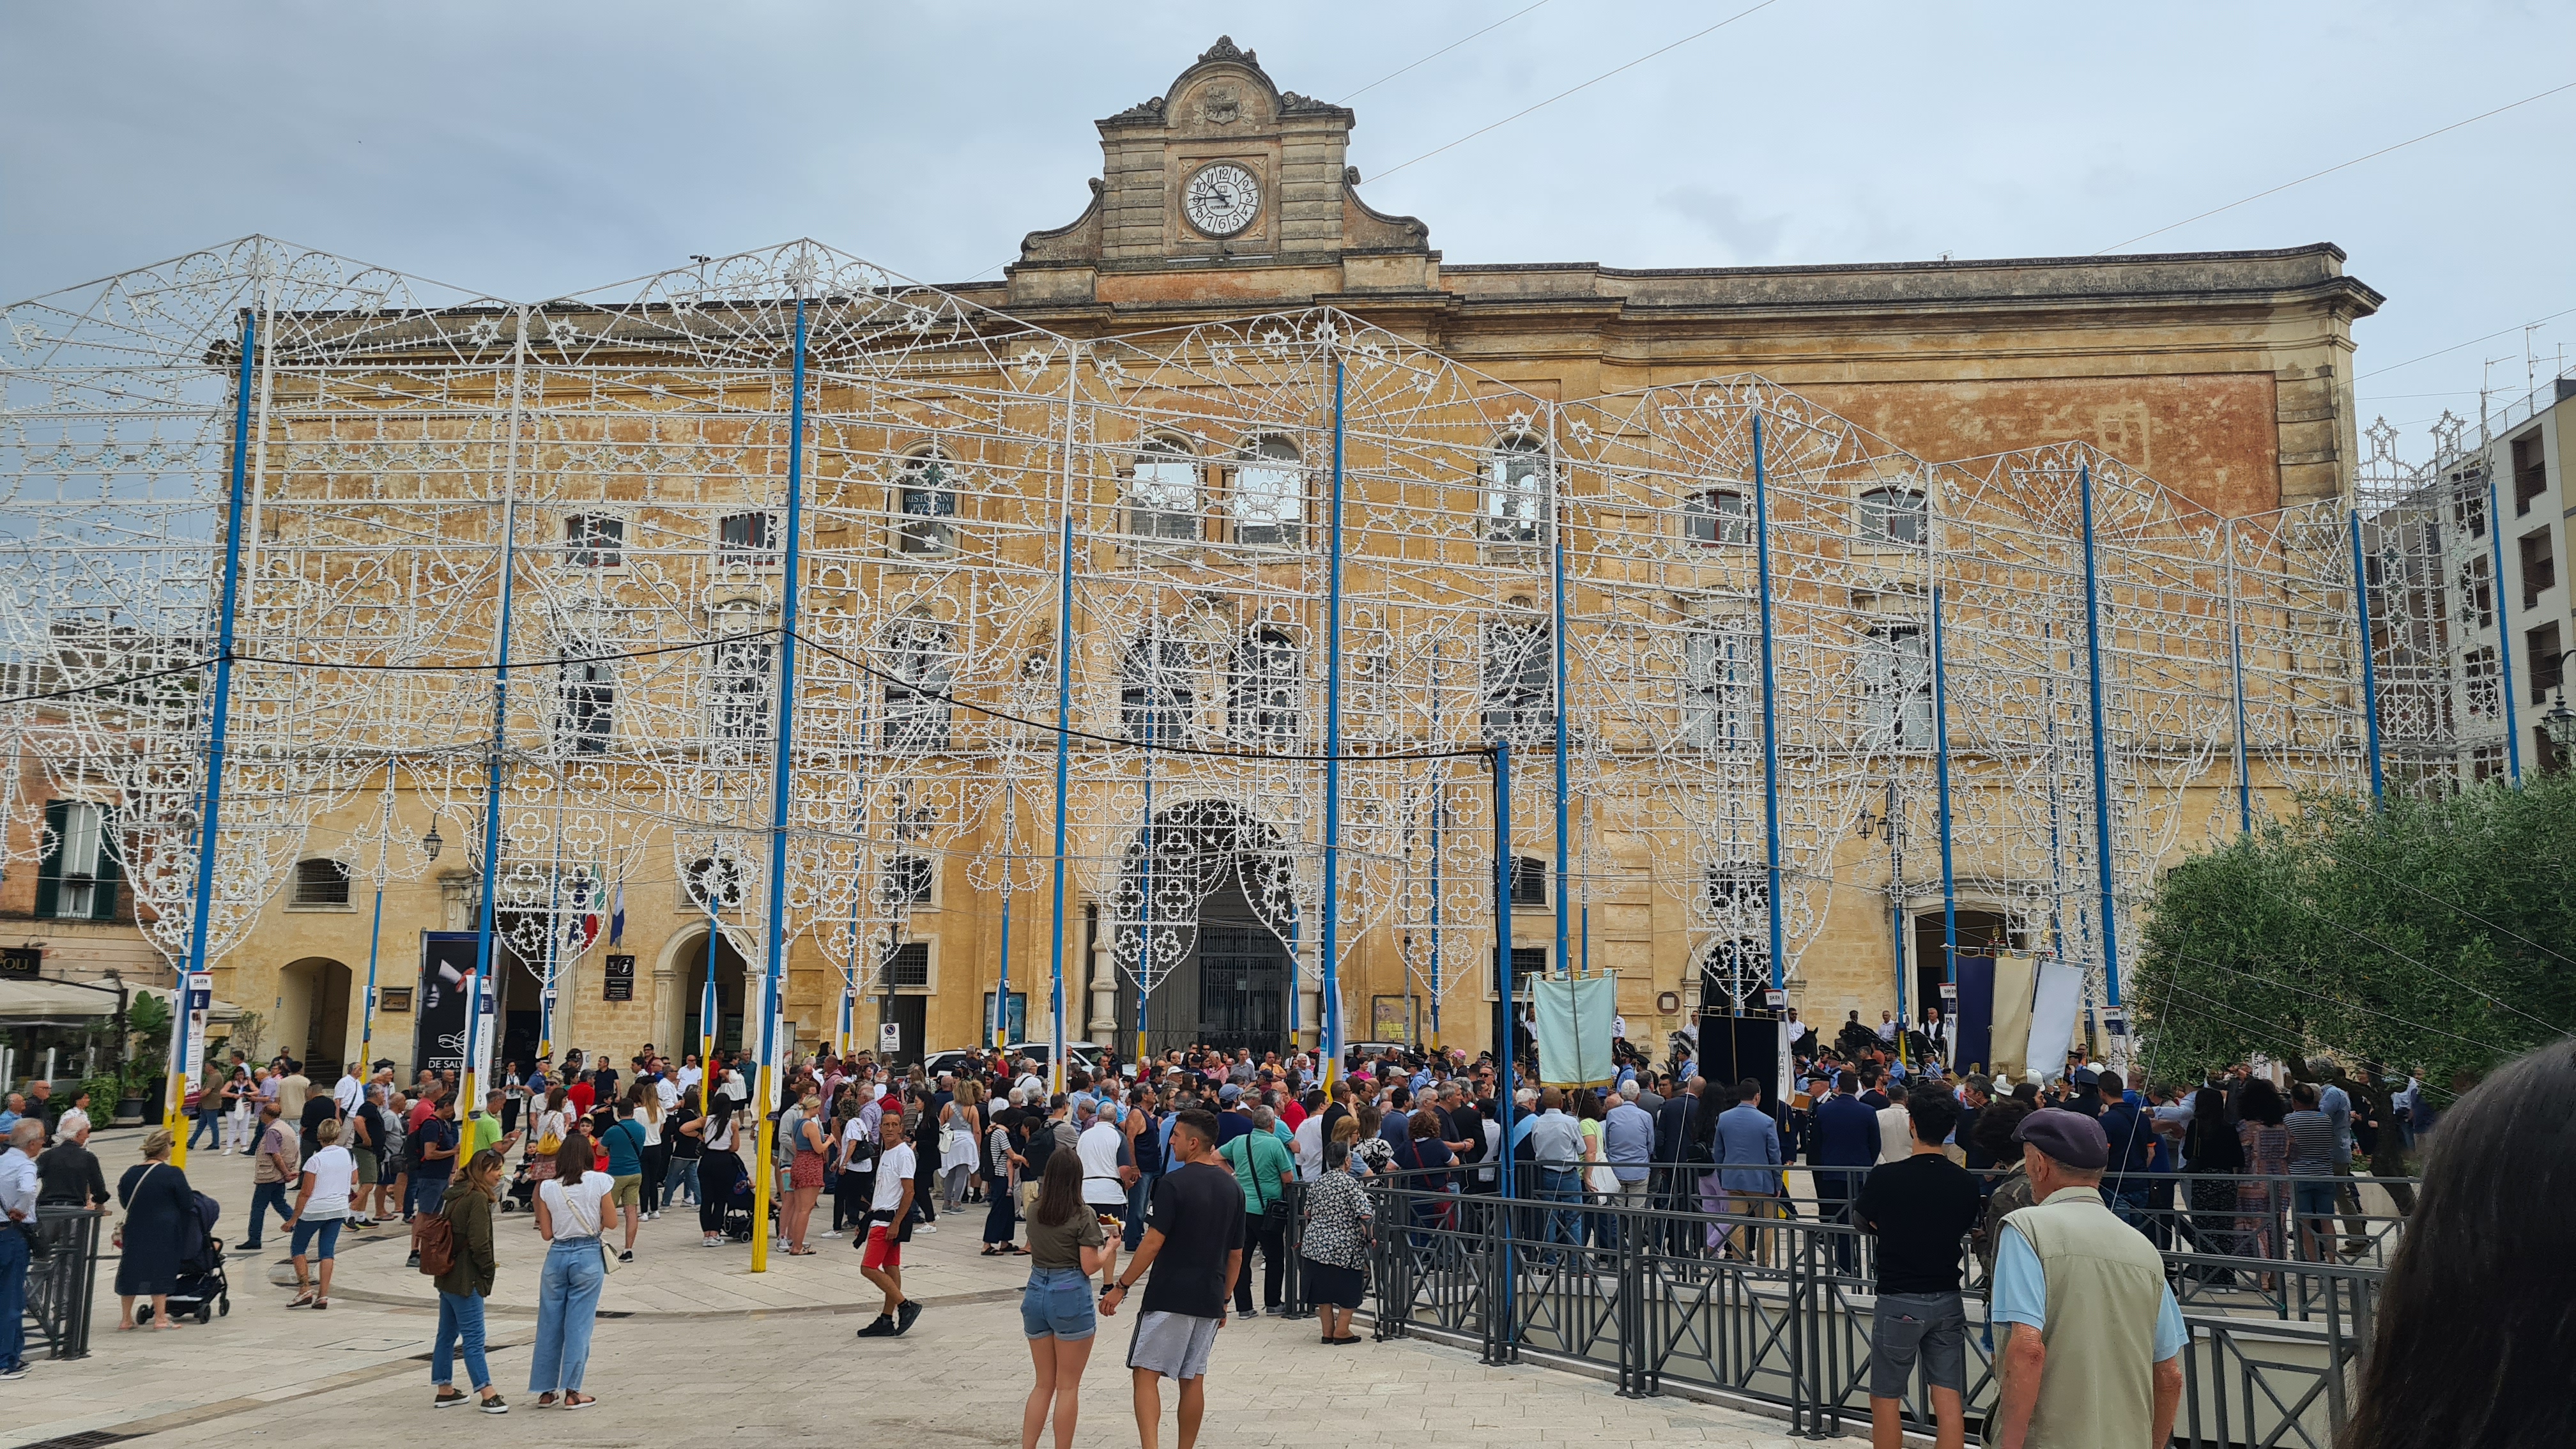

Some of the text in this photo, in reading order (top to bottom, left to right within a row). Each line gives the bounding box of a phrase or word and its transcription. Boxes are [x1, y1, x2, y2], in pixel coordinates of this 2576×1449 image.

[1207, 172, 1214, 183] 11
[1218, 169, 1229, 180] 12
[1233, 172, 1237, 183] 1
[1195, 181, 1206, 193] 10
[1243, 180, 1249, 190] 2
[1193, 195, 1200, 205] 9
[1246, 192, 1253, 203] 3
[1196, 207, 1203, 218] 8
[1241, 205, 1248, 216] 4
[1206, 217, 1213, 227] 7
[1218, 218, 1226, 229] 6
[1232, 215, 1239, 226] 5
